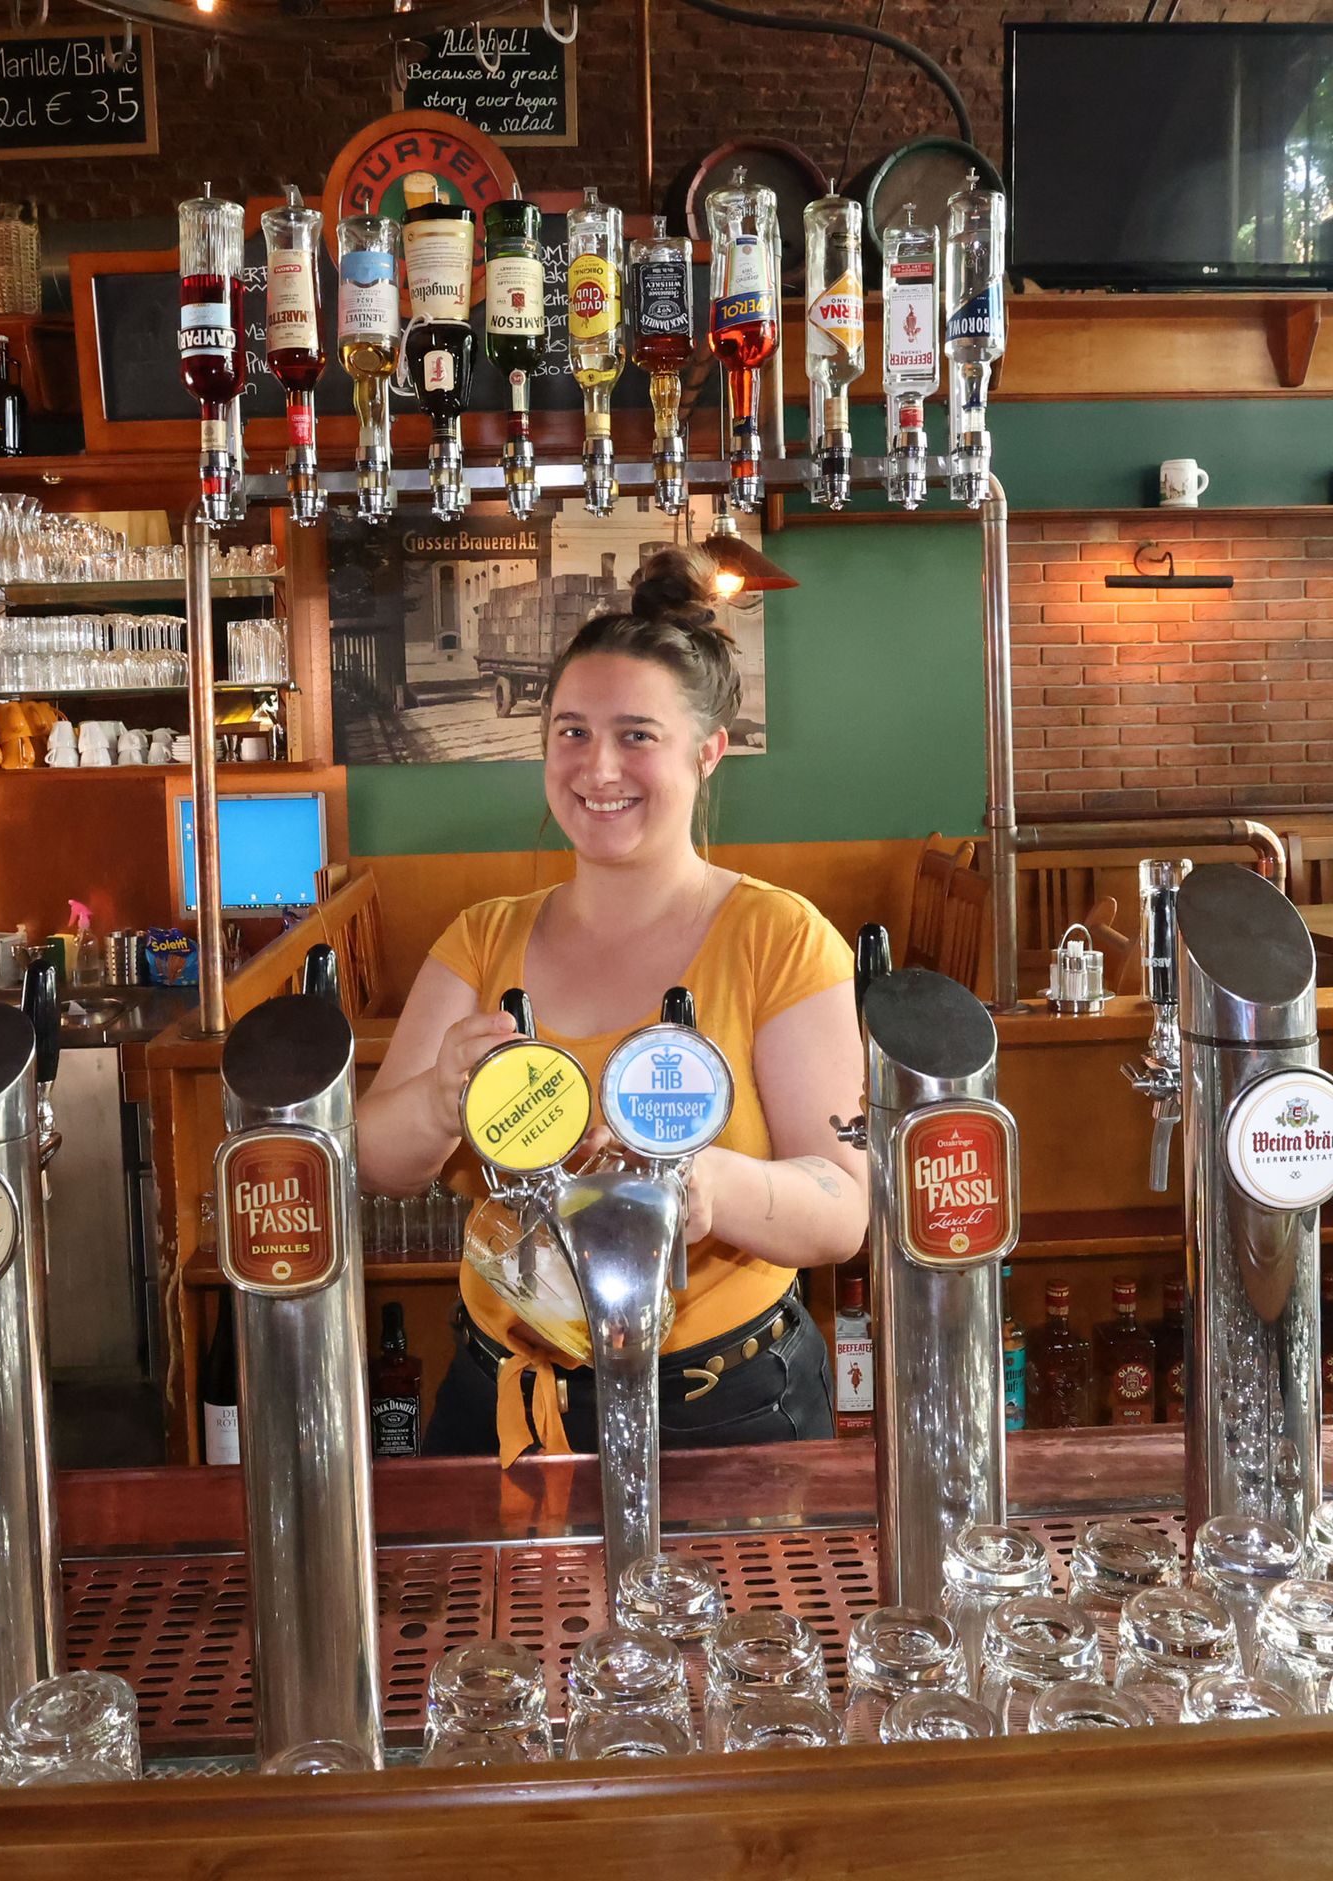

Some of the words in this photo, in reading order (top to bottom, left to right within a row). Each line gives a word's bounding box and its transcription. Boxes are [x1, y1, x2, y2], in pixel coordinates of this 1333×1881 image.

[407, 62, 483, 80] Because
[510, 65, 558, 88] great
[45, 91, 72, 125] €
[87, 87, 139, 123] 3,5
[423, 91, 466, 115] story
[476, 95, 513, 106] ever
[515, 92, 558, 113] began
[479, 120, 491, 132] a
[350, 138, 491, 211] GÜRTEL
[576, 287, 600, 299] Club
[721, 296, 772, 320] APEROL
[491, 315, 543, 328] JAMESON
[669, 313, 689, 328] JACK
[889, 352, 933, 366] BEEFEATER
[459, 531, 516, 550] Brauerei
[151, 937, 188, 952] Soletti
[485, 1068, 565, 1145] Ottakringer
[628, 1095, 707, 1122] Tegernseer
[521, 1106, 565, 1148] HELLES
[654, 1118, 686, 1140] Bier
[937, 1139, 974, 1148] Ottakringer
[1252, 1131, 1302, 1153] Weitra
[1256, 1153, 1333, 1164] BIERWERKSTAT
[914, 1150, 978, 1190] GOLD
[235, 1177, 300, 1215] GOLD
[928, 1178, 1000, 1213] FASSL
[249, 1207, 322, 1238] FASSL
[929, 1207, 993, 1230] Zwickl
[251, 1243, 311, 1255] DUNKLES
[1118, 1385, 1149, 1398] TEQUILA
